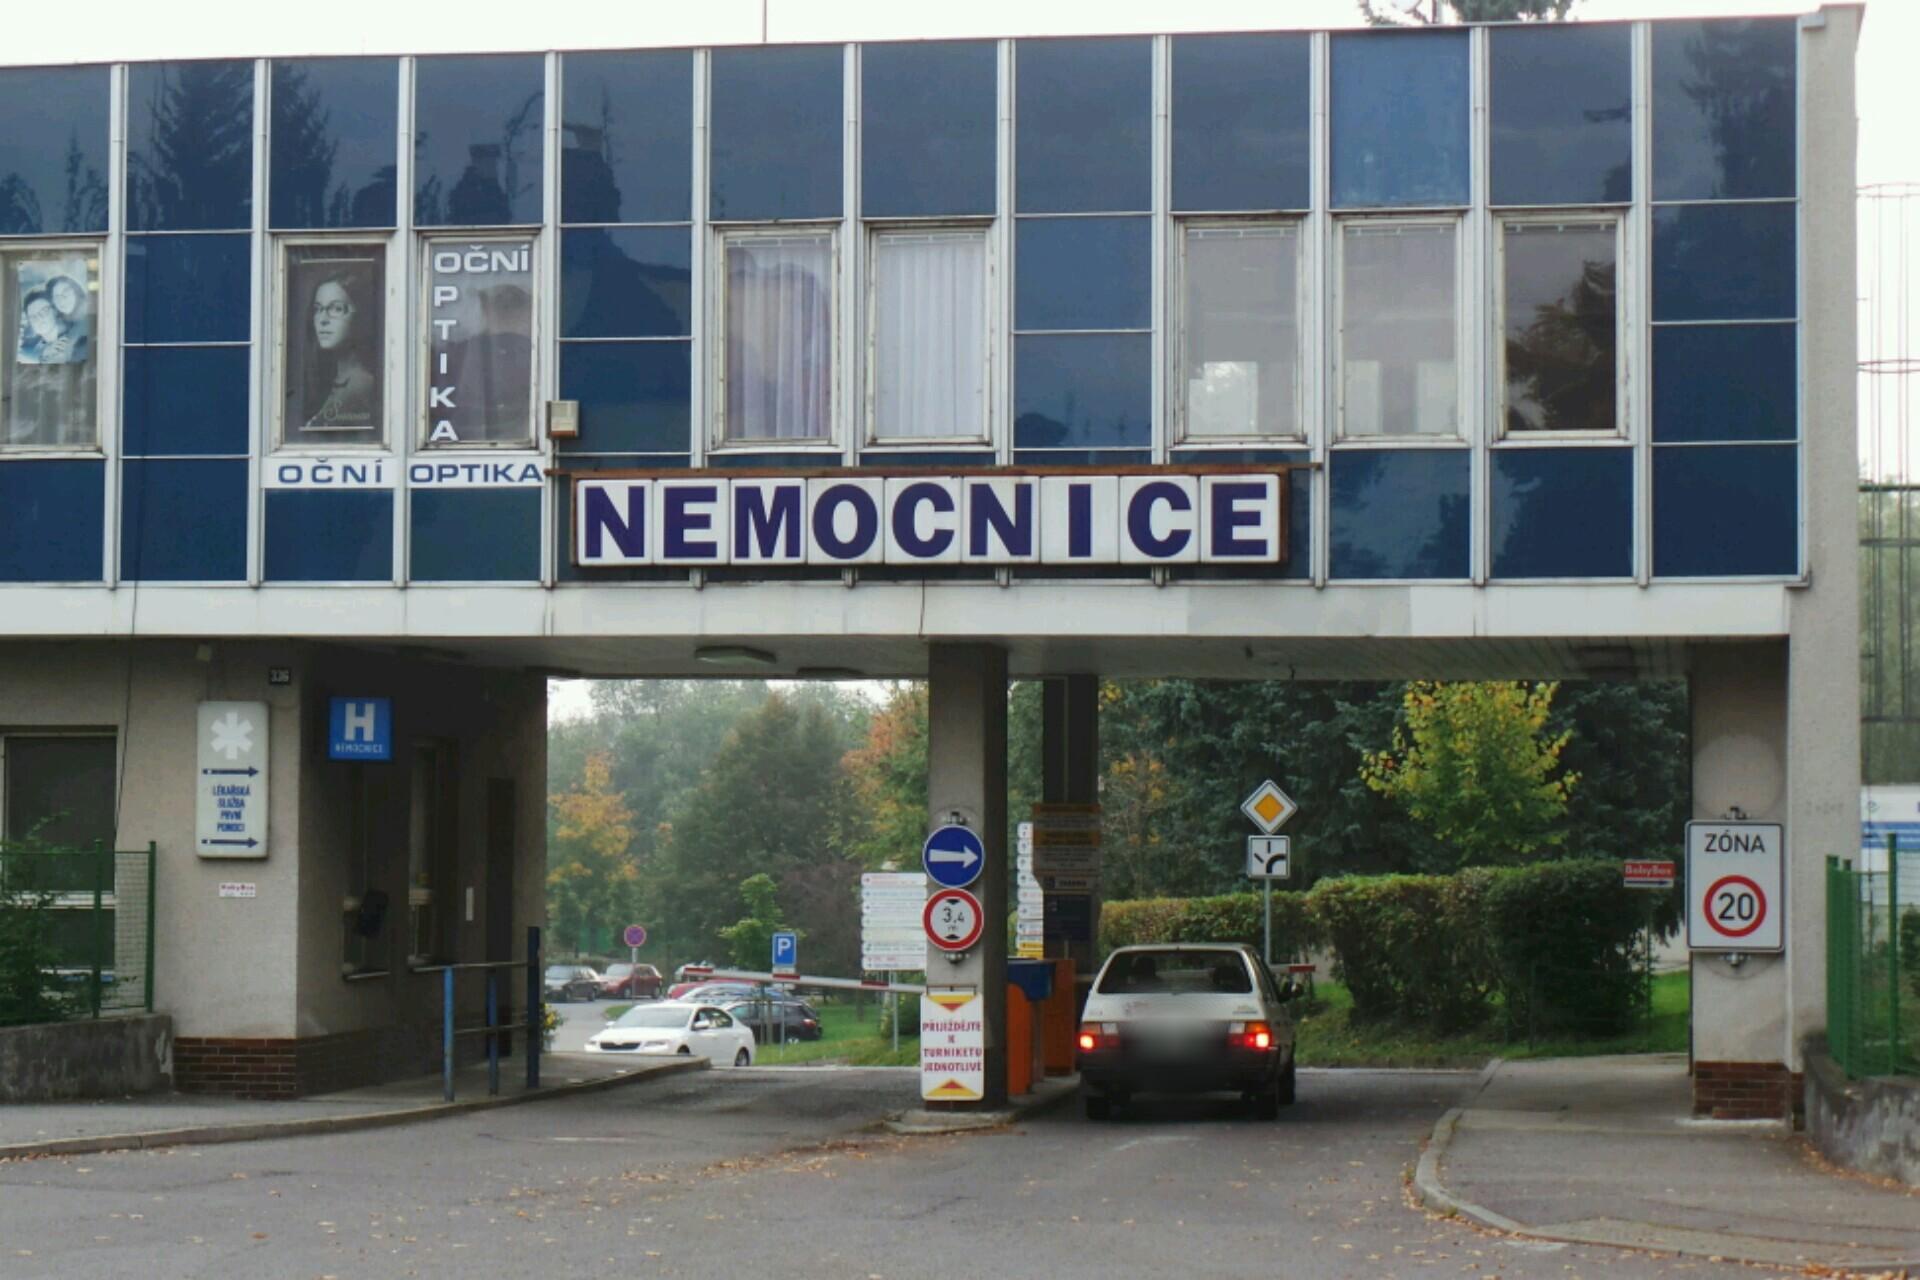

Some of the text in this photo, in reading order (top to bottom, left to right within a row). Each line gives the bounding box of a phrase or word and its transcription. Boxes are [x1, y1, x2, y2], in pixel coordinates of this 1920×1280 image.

[434, 244, 529, 273] OČNÍ
[278, 456, 543, 483] OČNÍ OPTIKA
[584, 482, 1268, 560] NEMOCNICE
[345, 703, 374, 741] H
[212, 784, 251, 796] LÉKAŘSKÁ
[217, 797, 245, 808] SLUŽBA
[1704, 829, 1766, 853] ZÓNA
[1718, 892, 1755, 921] 20
[777, 937, 791, 957] P
[948, 1034, 956, 1043] K
[923, 1047, 983, 1057] TURNIKETU
